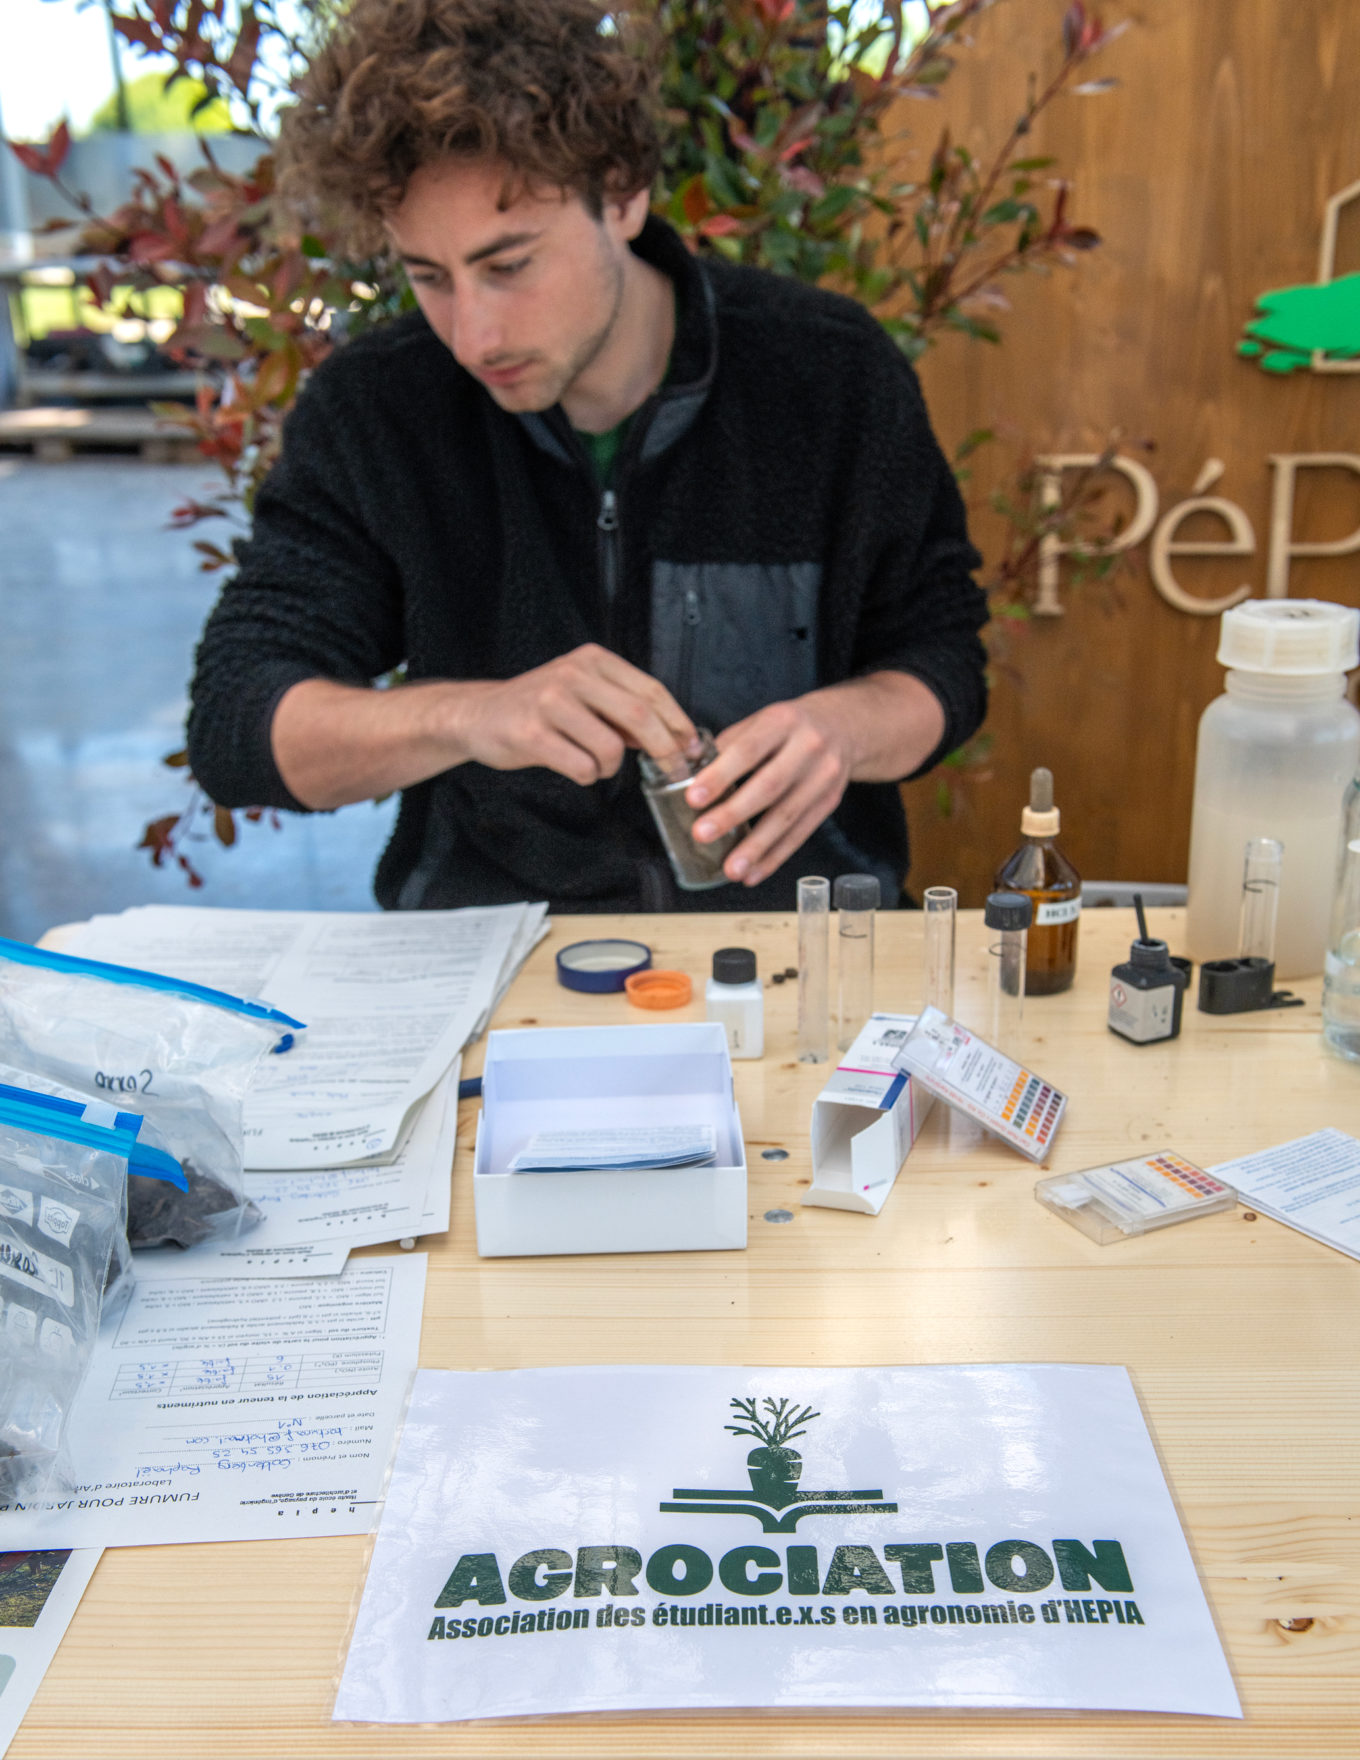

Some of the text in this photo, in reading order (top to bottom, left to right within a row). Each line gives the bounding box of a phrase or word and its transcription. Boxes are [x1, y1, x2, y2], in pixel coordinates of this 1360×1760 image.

[307, 1390, 378, 1401] Appréciation
[157, 1400, 219, 1409] nutriments
[315, 1413, 345, 1421] parcelle
[105, 1480, 172, 1490] Laboratoire
[79, 1497, 124, 1509] POUR
[128, 1492, 200, 1506] FUMURE
[433, 1539, 1135, 1608] AGROCIATION
[427, 1599, 1145, 1640] Association des étudiant.e.x.s en agronomie d'HEPIA
